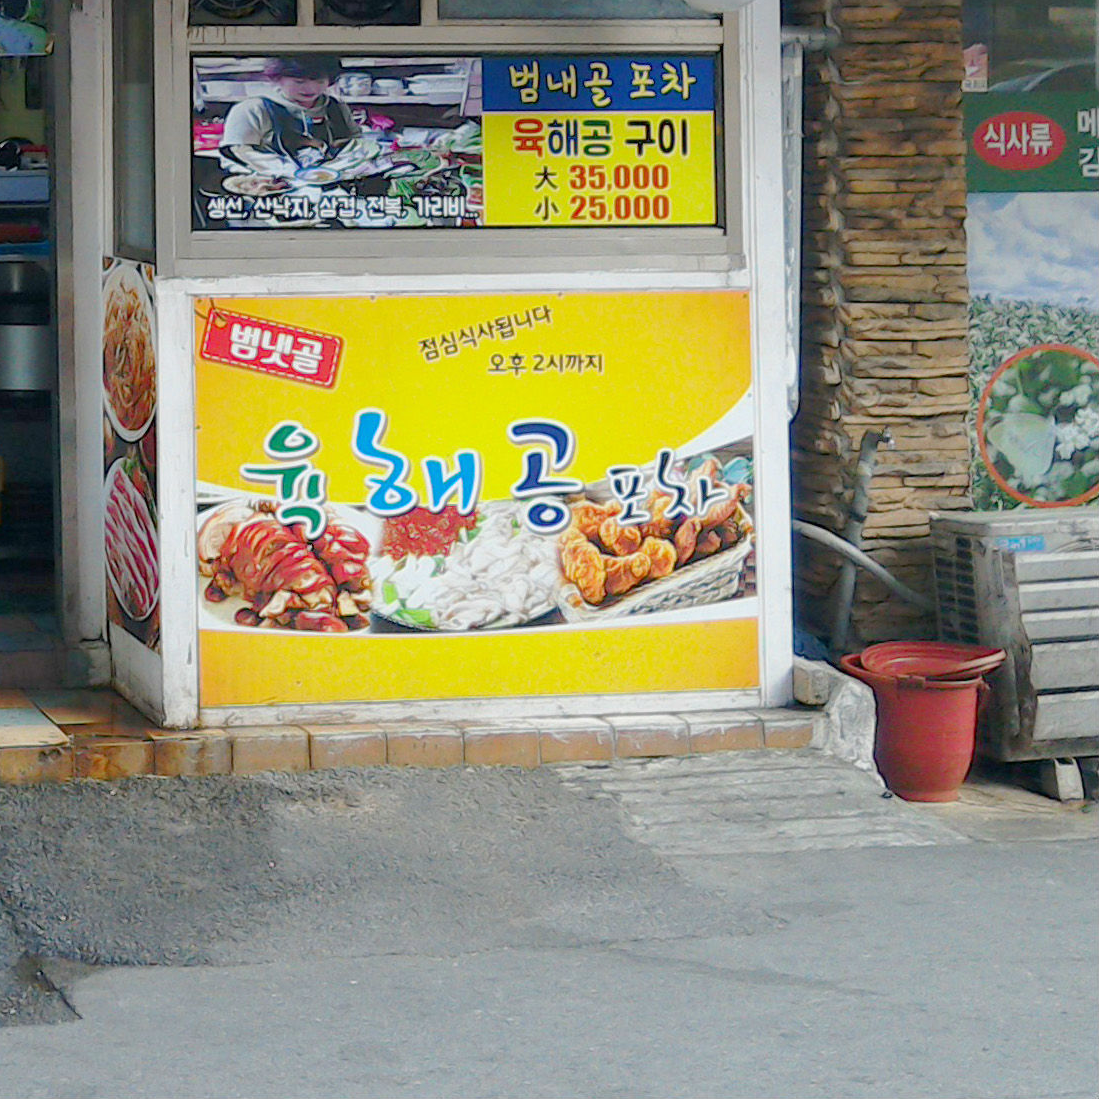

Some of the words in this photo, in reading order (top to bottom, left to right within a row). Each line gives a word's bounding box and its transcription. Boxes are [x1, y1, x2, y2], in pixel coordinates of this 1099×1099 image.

[509, 61, 612, 108] 범내골
[630, 62, 697, 100] 포차
[513, 118, 612, 158] 육해공
[625, 118, 687, 157] 구이
[983, 122, 1053, 156] 식사류
[534, 166, 558, 190] 大
[569, 164, 669, 191] 35,000
[207, 196, 248, 219] 생선,
[253, 196, 314, 219] 산낙지,
[366, 196, 407, 219] 전복,
[534, 196, 559, 221] 小
[569, 195, 670, 222] 25,000
[229, 323, 325, 376] 범냇골
[417, 304, 554, 362] 점심식사됩니다
[487, 353, 527, 376] 오후
[532, 353, 604, 375] 2시까지
[610, 449, 731, 526] 포차
